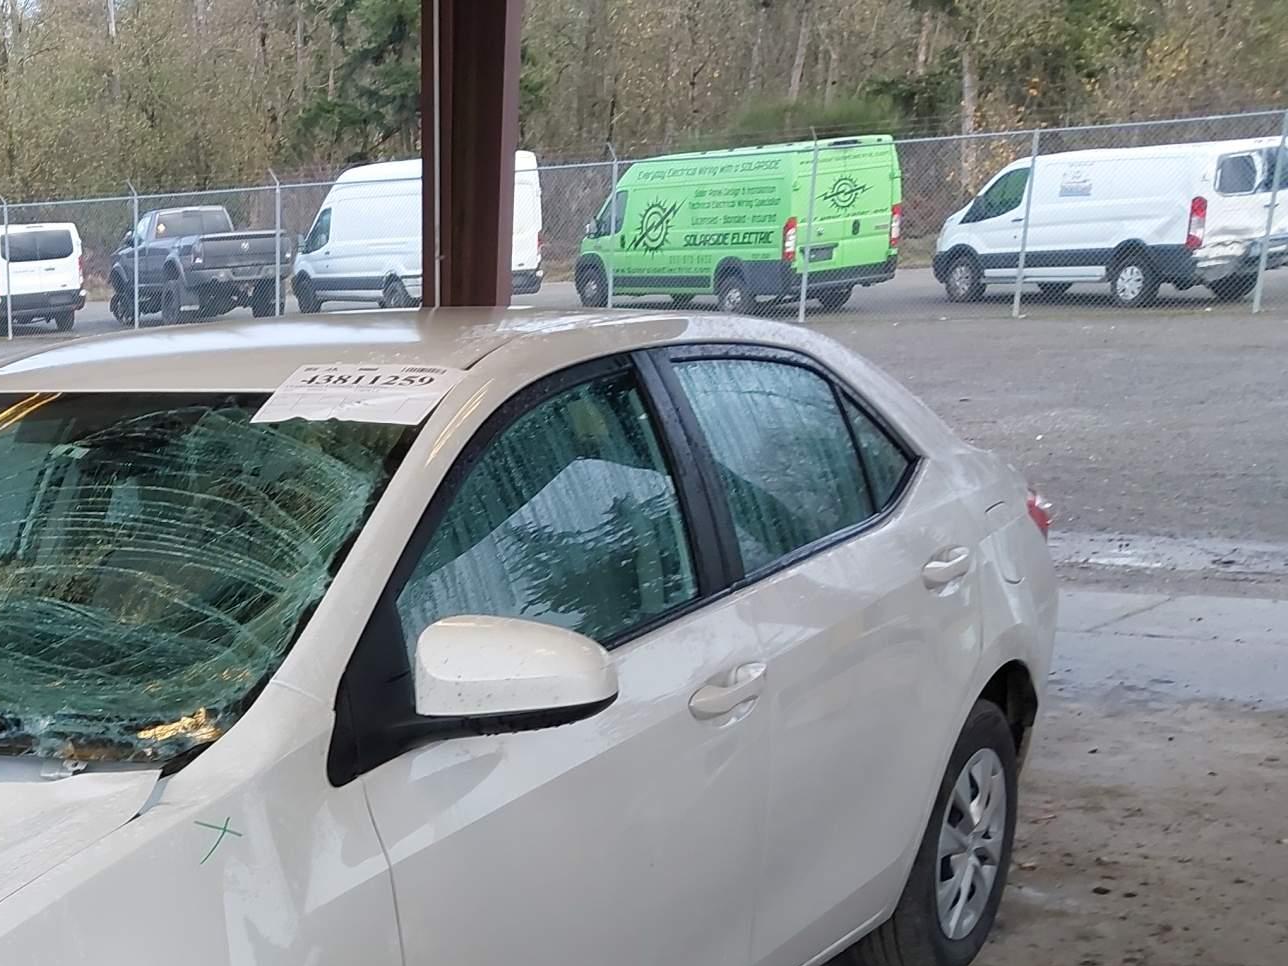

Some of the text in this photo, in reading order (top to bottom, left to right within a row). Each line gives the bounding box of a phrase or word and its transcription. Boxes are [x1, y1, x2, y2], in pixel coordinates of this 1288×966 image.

[683, 230, 775, 248] SOLARSIDE ELECTRIC
[301, 374, 435, 387] 43811259
